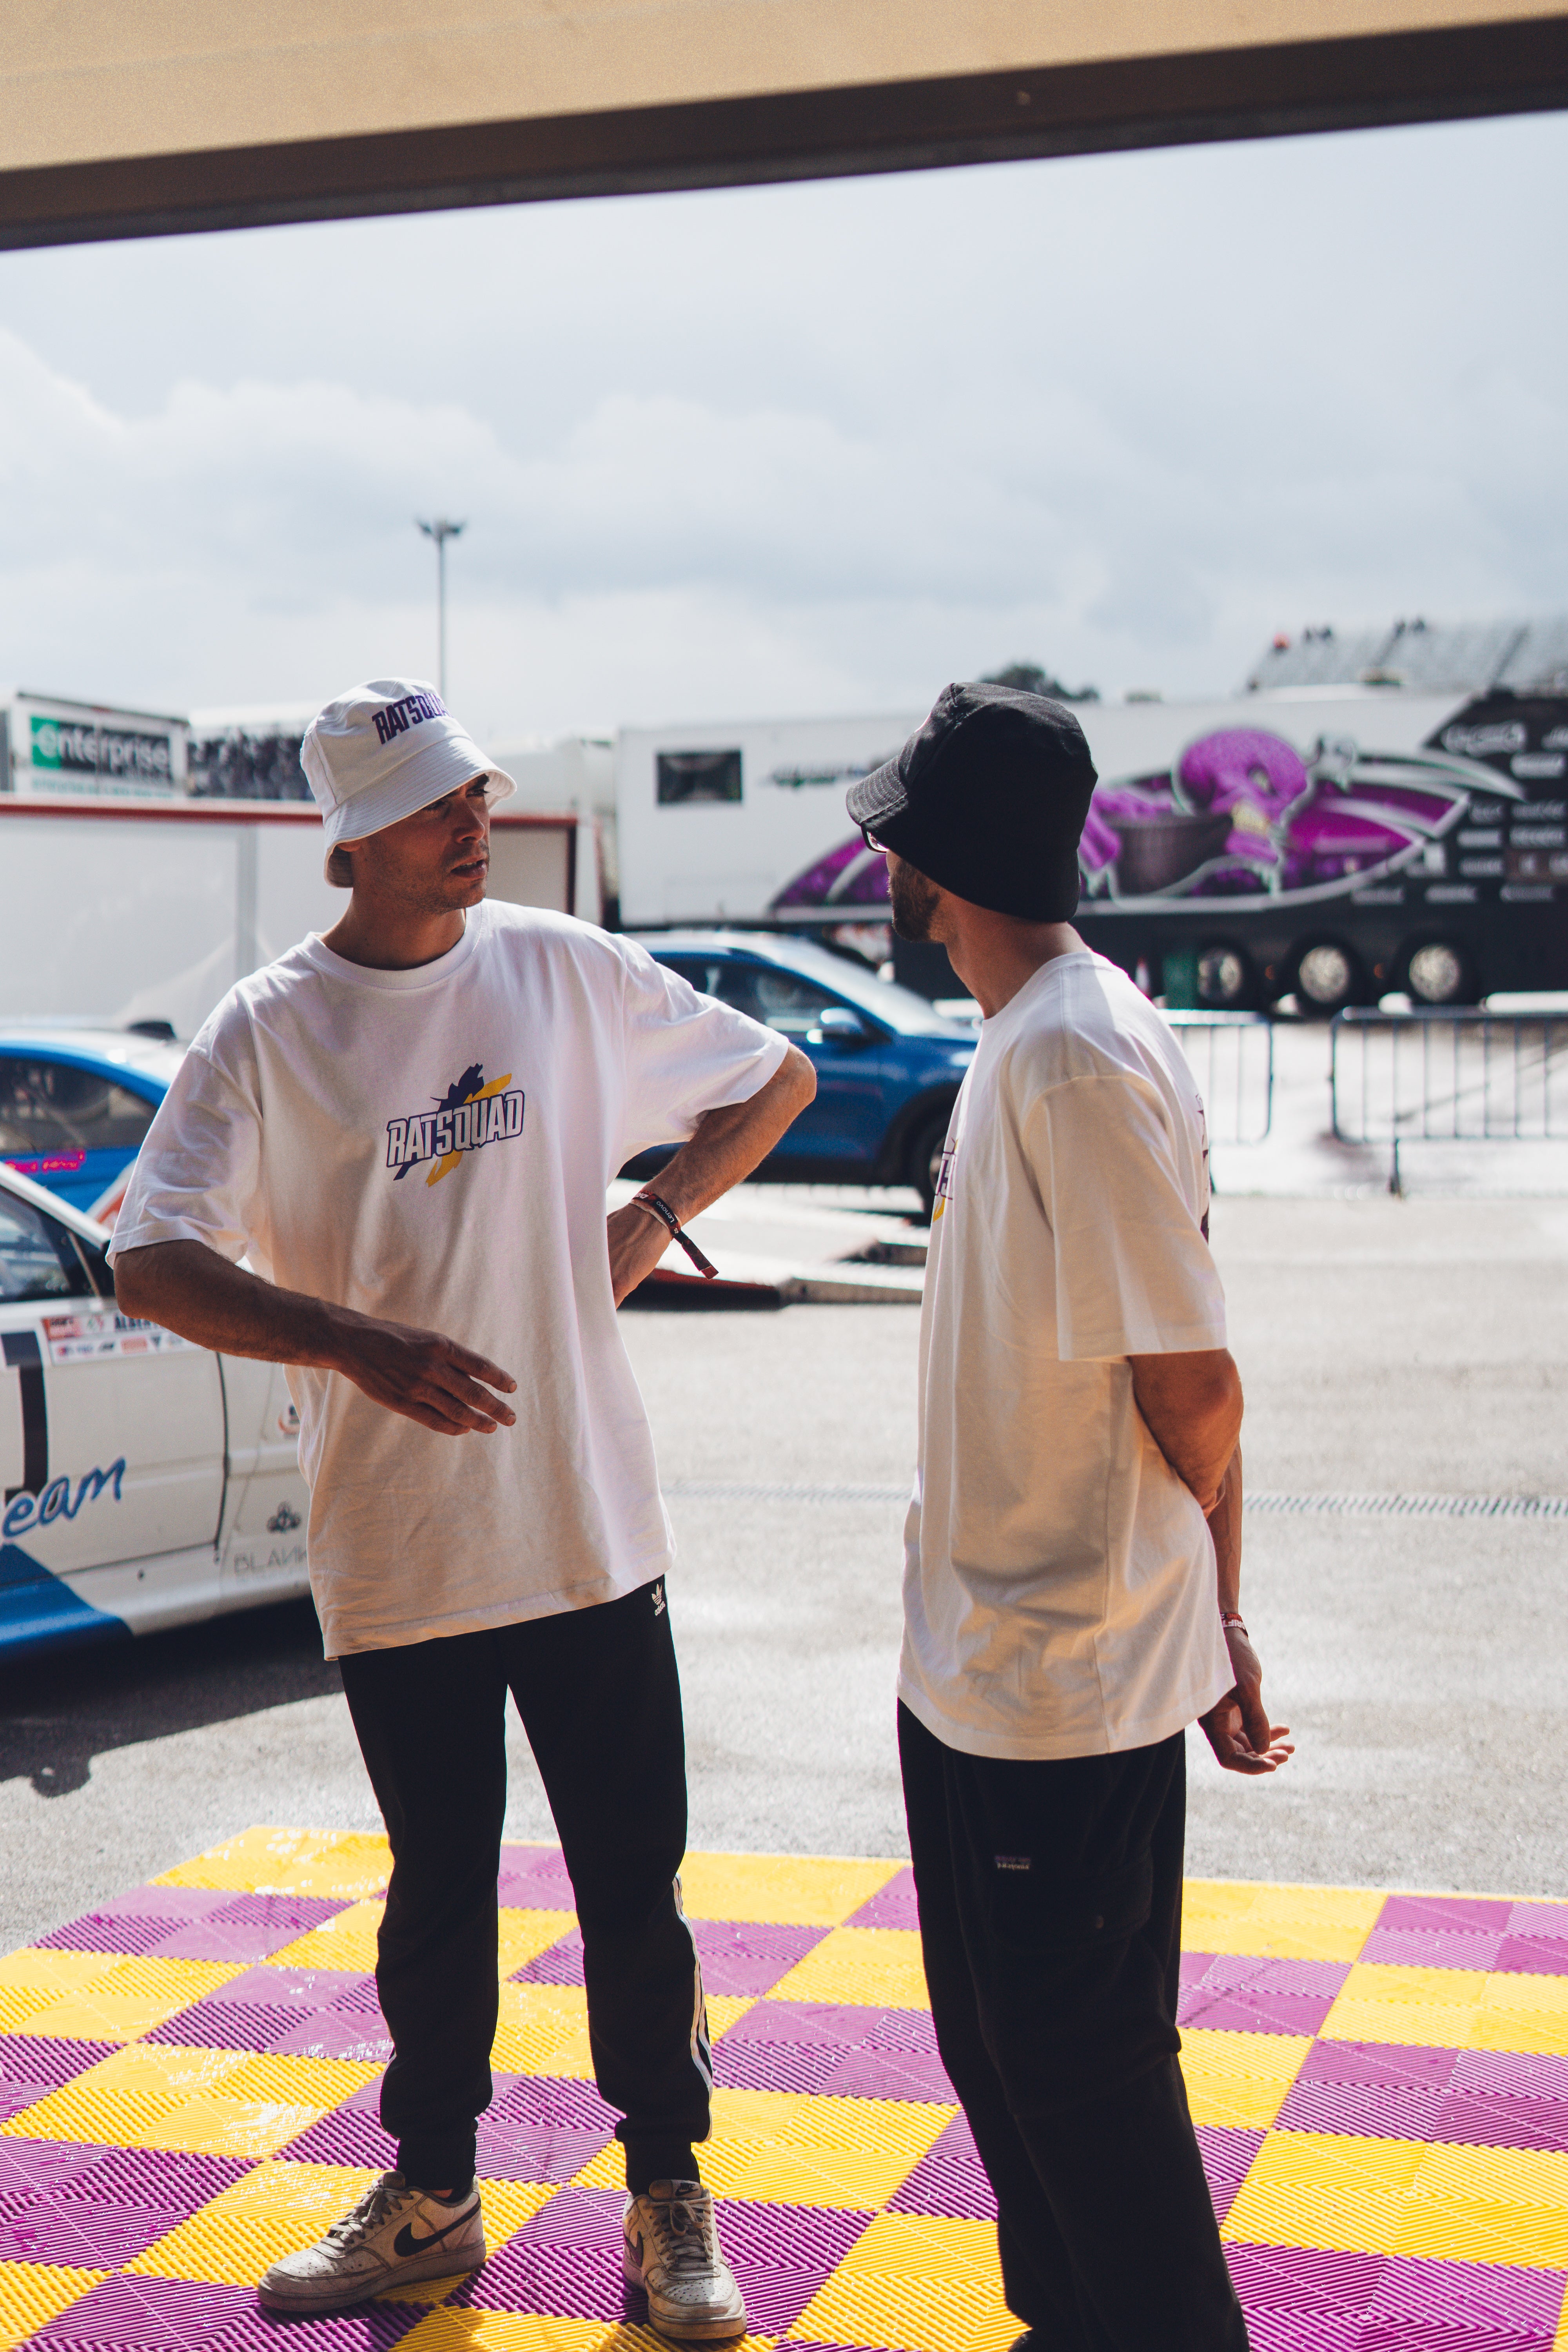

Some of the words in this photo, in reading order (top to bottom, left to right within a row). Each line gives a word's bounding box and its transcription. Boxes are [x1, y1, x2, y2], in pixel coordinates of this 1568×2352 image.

[38, 722, 169, 772] enterprise
[387, 1090, 524, 1167] RATSQUAD
[656, 1201, 675, 1223] Lenovo
